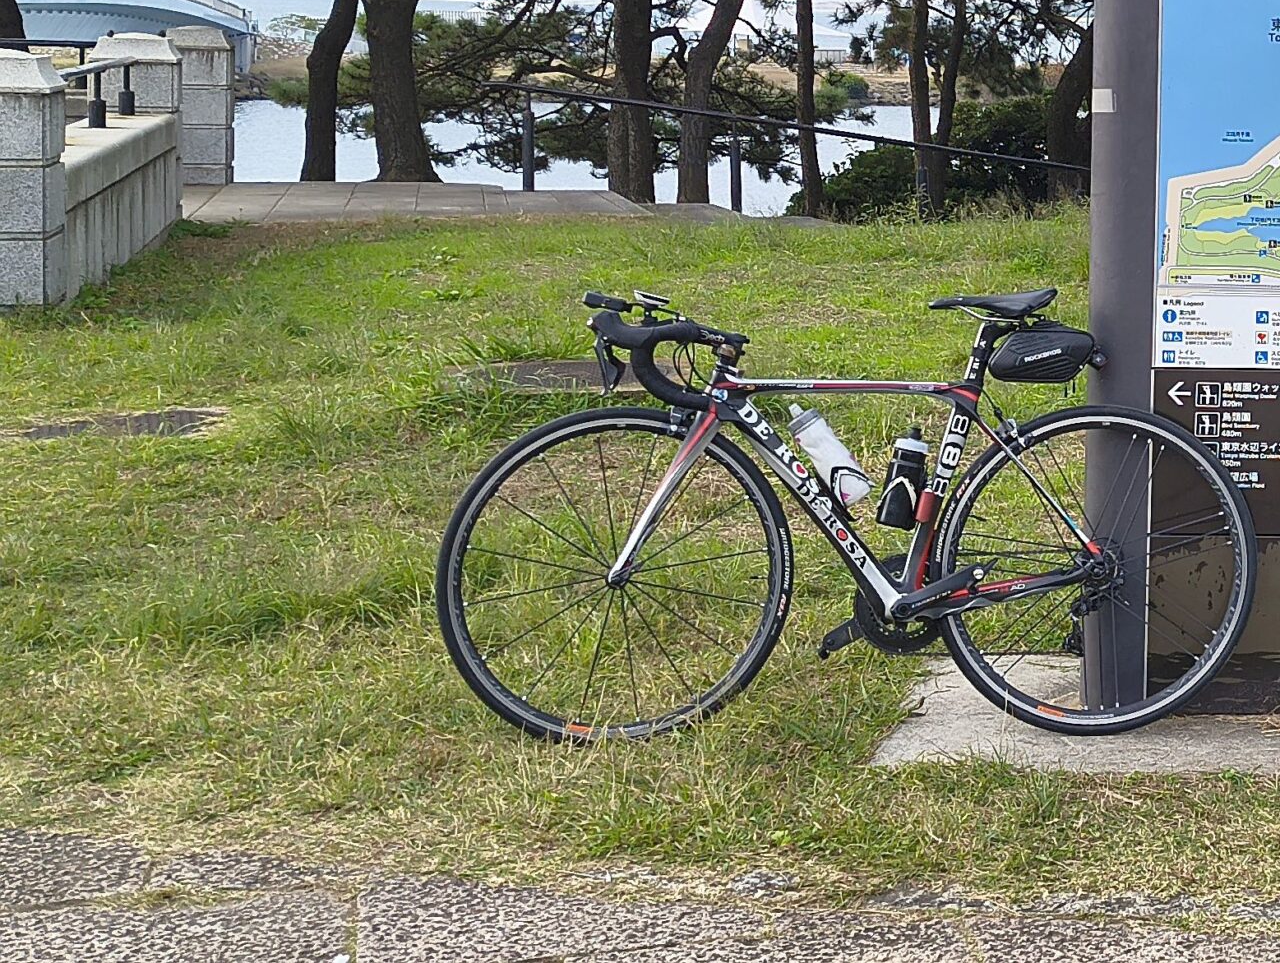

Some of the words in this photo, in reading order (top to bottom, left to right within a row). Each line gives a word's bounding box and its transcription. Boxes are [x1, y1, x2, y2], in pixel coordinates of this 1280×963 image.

[737, 402, 775, 440] DE
[1222, 412, 1252, 423] 鳥類園
[797, 483, 821, 512] DE
[822, 513, 868, 570] ROSA
